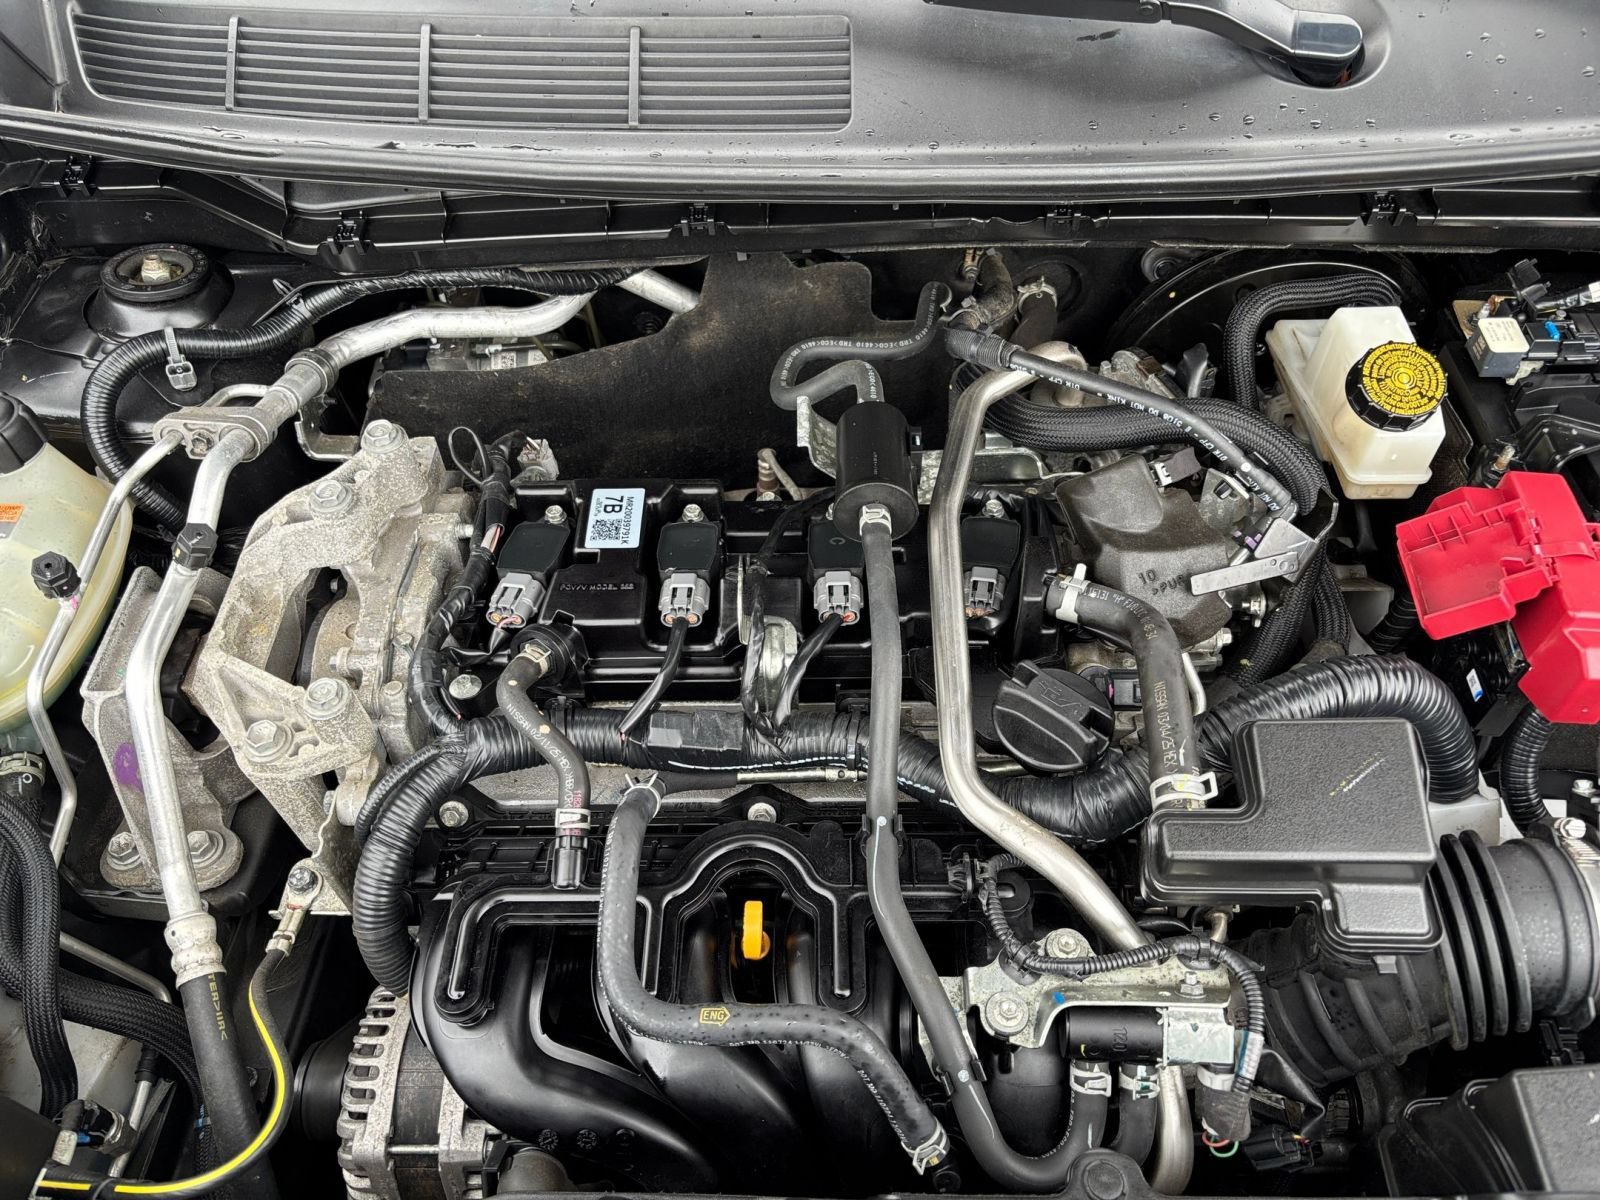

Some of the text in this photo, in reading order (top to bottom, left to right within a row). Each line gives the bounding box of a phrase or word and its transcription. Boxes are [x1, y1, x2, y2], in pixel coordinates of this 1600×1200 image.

[603, 495, 624, 514] 7B
[1153, 680, 1169, 711] NISSAN
[505, 703, 532, 731] NISSAN
[703, 1010, 724, 1020] ENG
